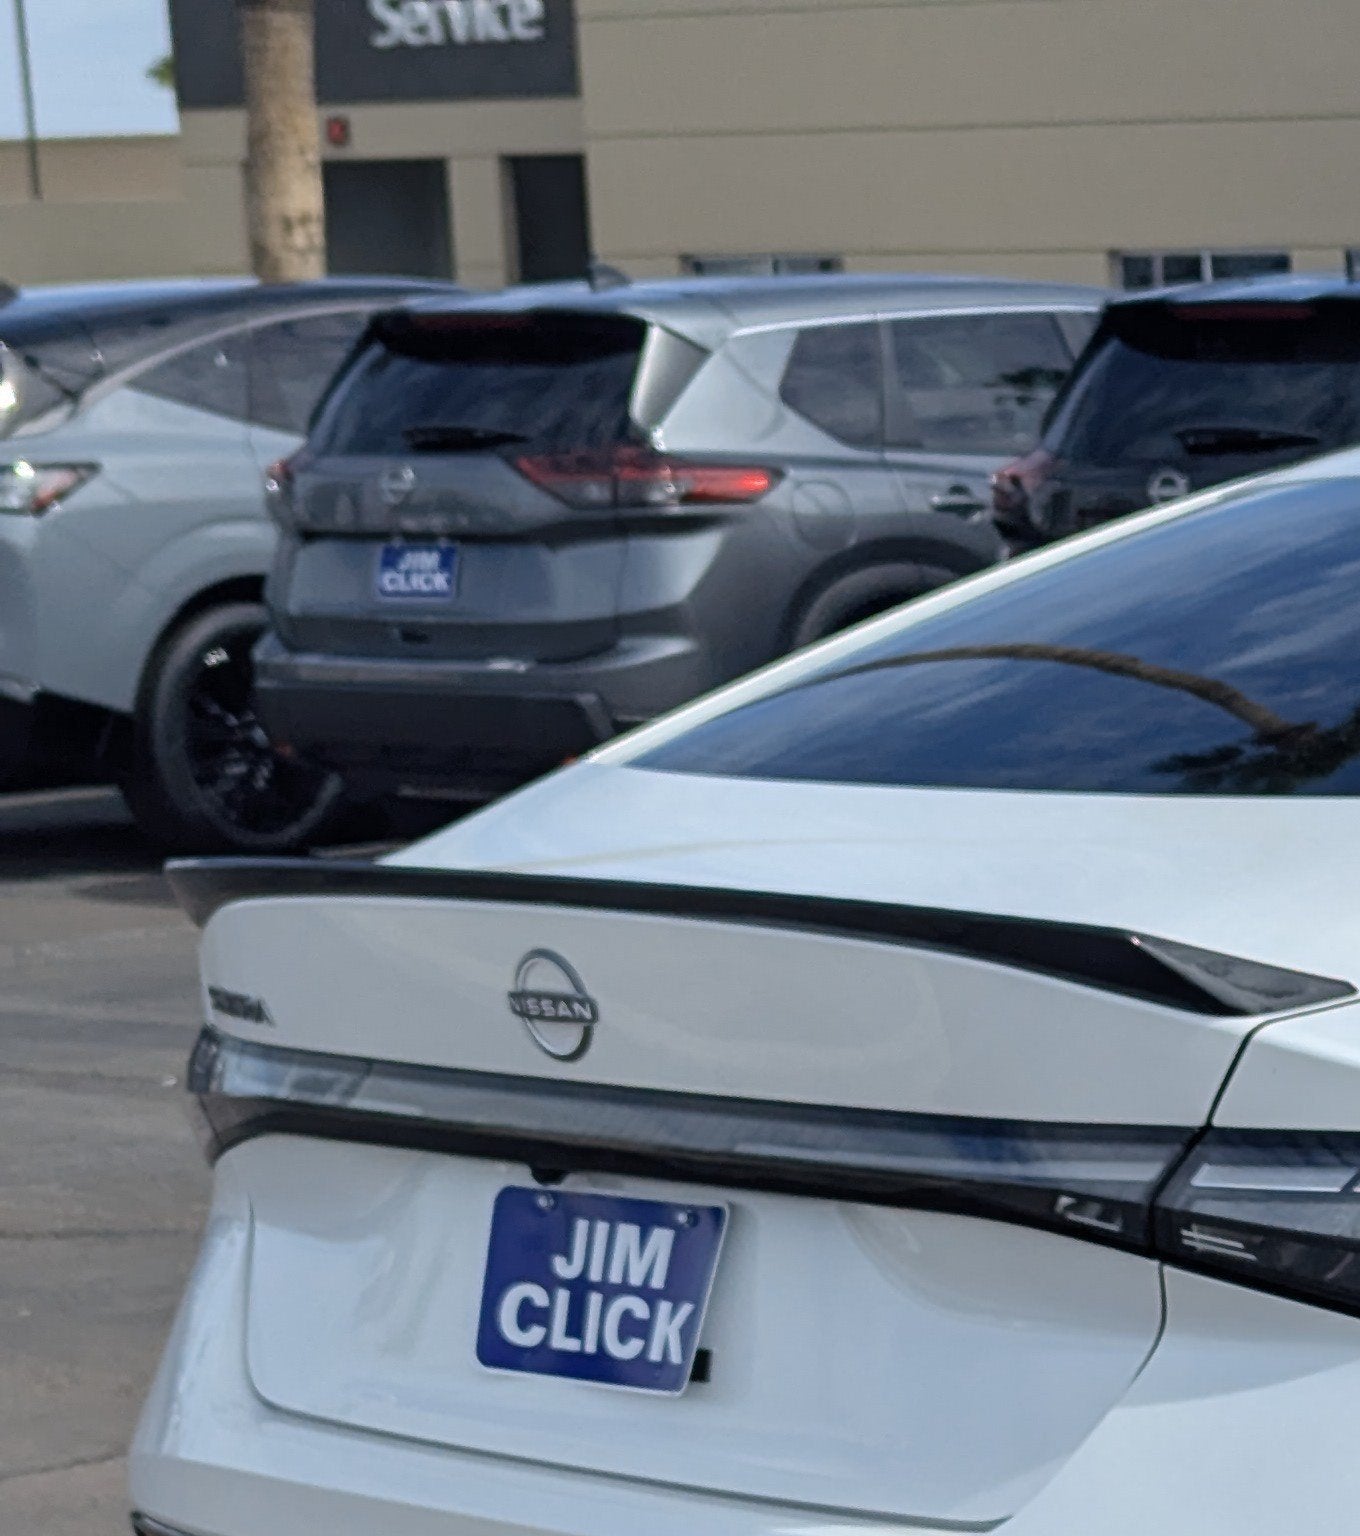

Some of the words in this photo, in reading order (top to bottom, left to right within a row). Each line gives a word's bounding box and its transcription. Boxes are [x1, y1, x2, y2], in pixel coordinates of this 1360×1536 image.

[369, 0, 545, 48] Service
[382, 570, 450, 592] CLICK
[510, 996, 593, 1020] NISSAN
[552, 1218, 675, 1290] JIM
[499, 1281, 695, 1365] CLICK
